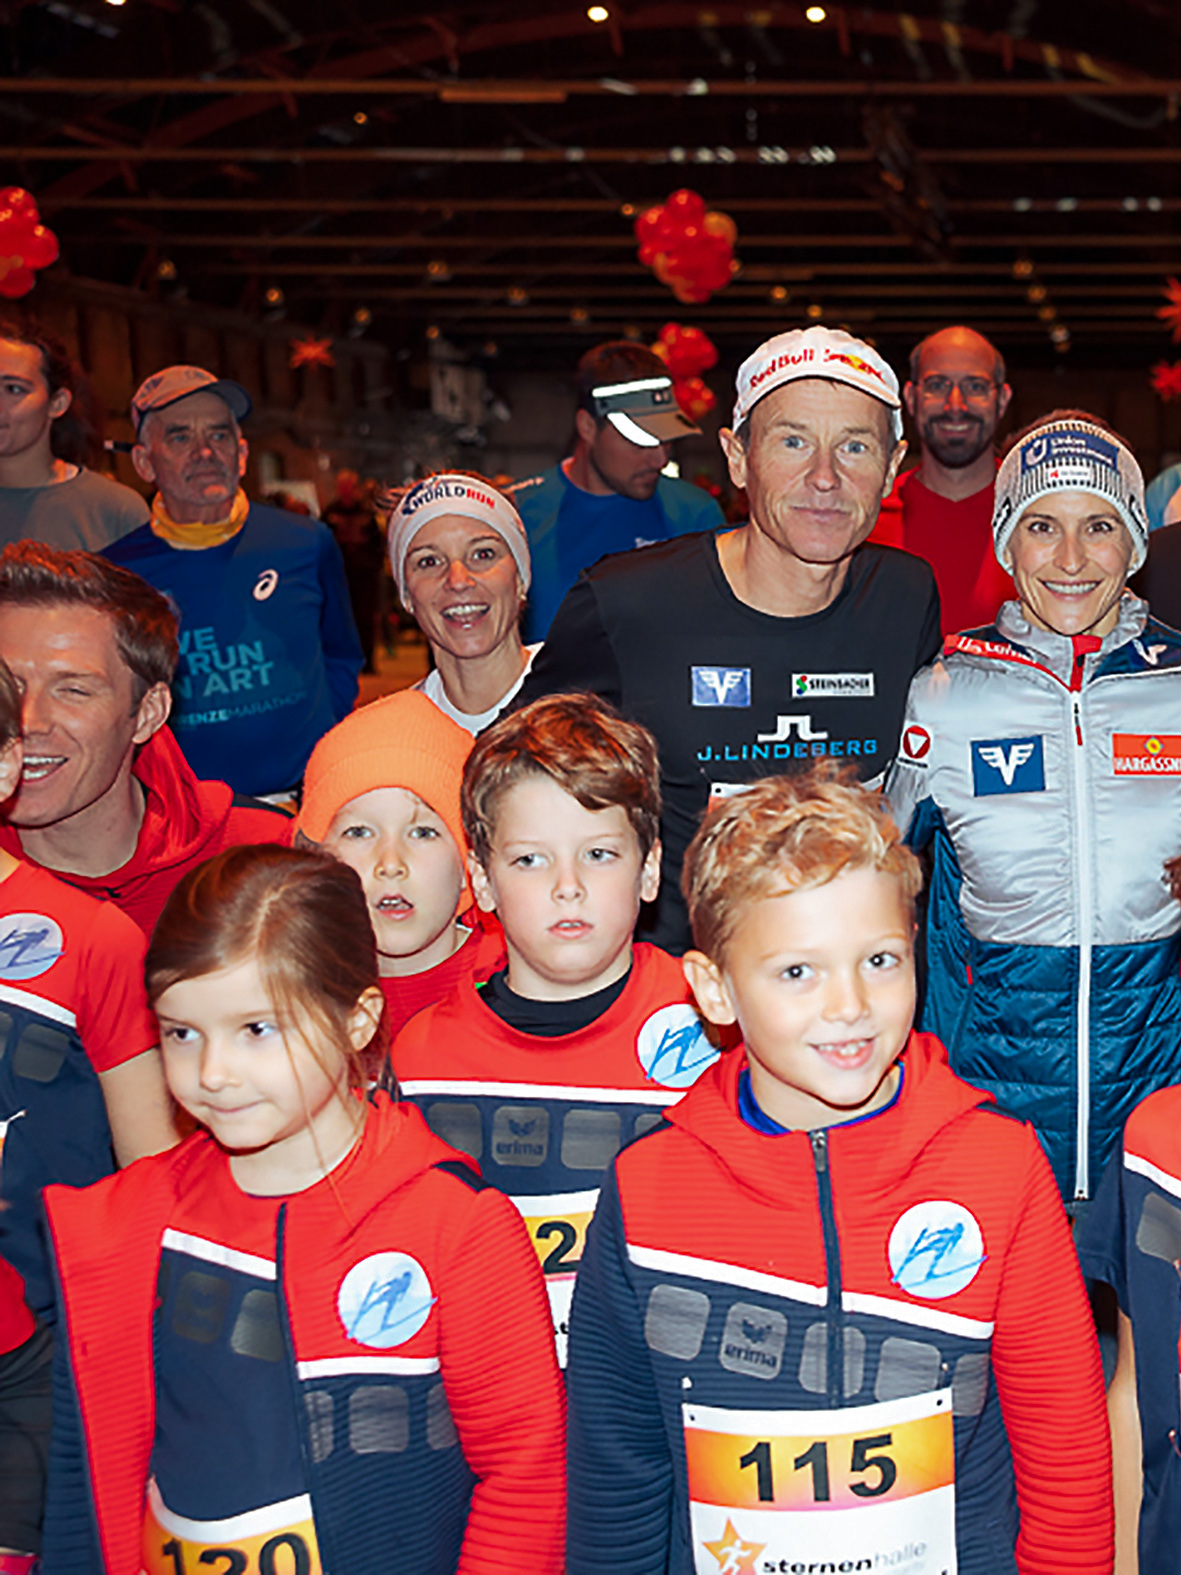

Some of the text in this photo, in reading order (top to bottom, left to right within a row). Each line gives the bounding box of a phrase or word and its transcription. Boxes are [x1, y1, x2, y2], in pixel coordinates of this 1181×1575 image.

[186, 640, 264, 675] RUN
[203, 661, 275, 697] ART
[697, 739, 878, 761] J.LINDEBERG
[496, 1140, 544, 1157] erima
[724, 1343, 778, 1369] erima
[739, 1432, 897, 1503] 115
[762, 1541, 928, 1575] sternenhalle
